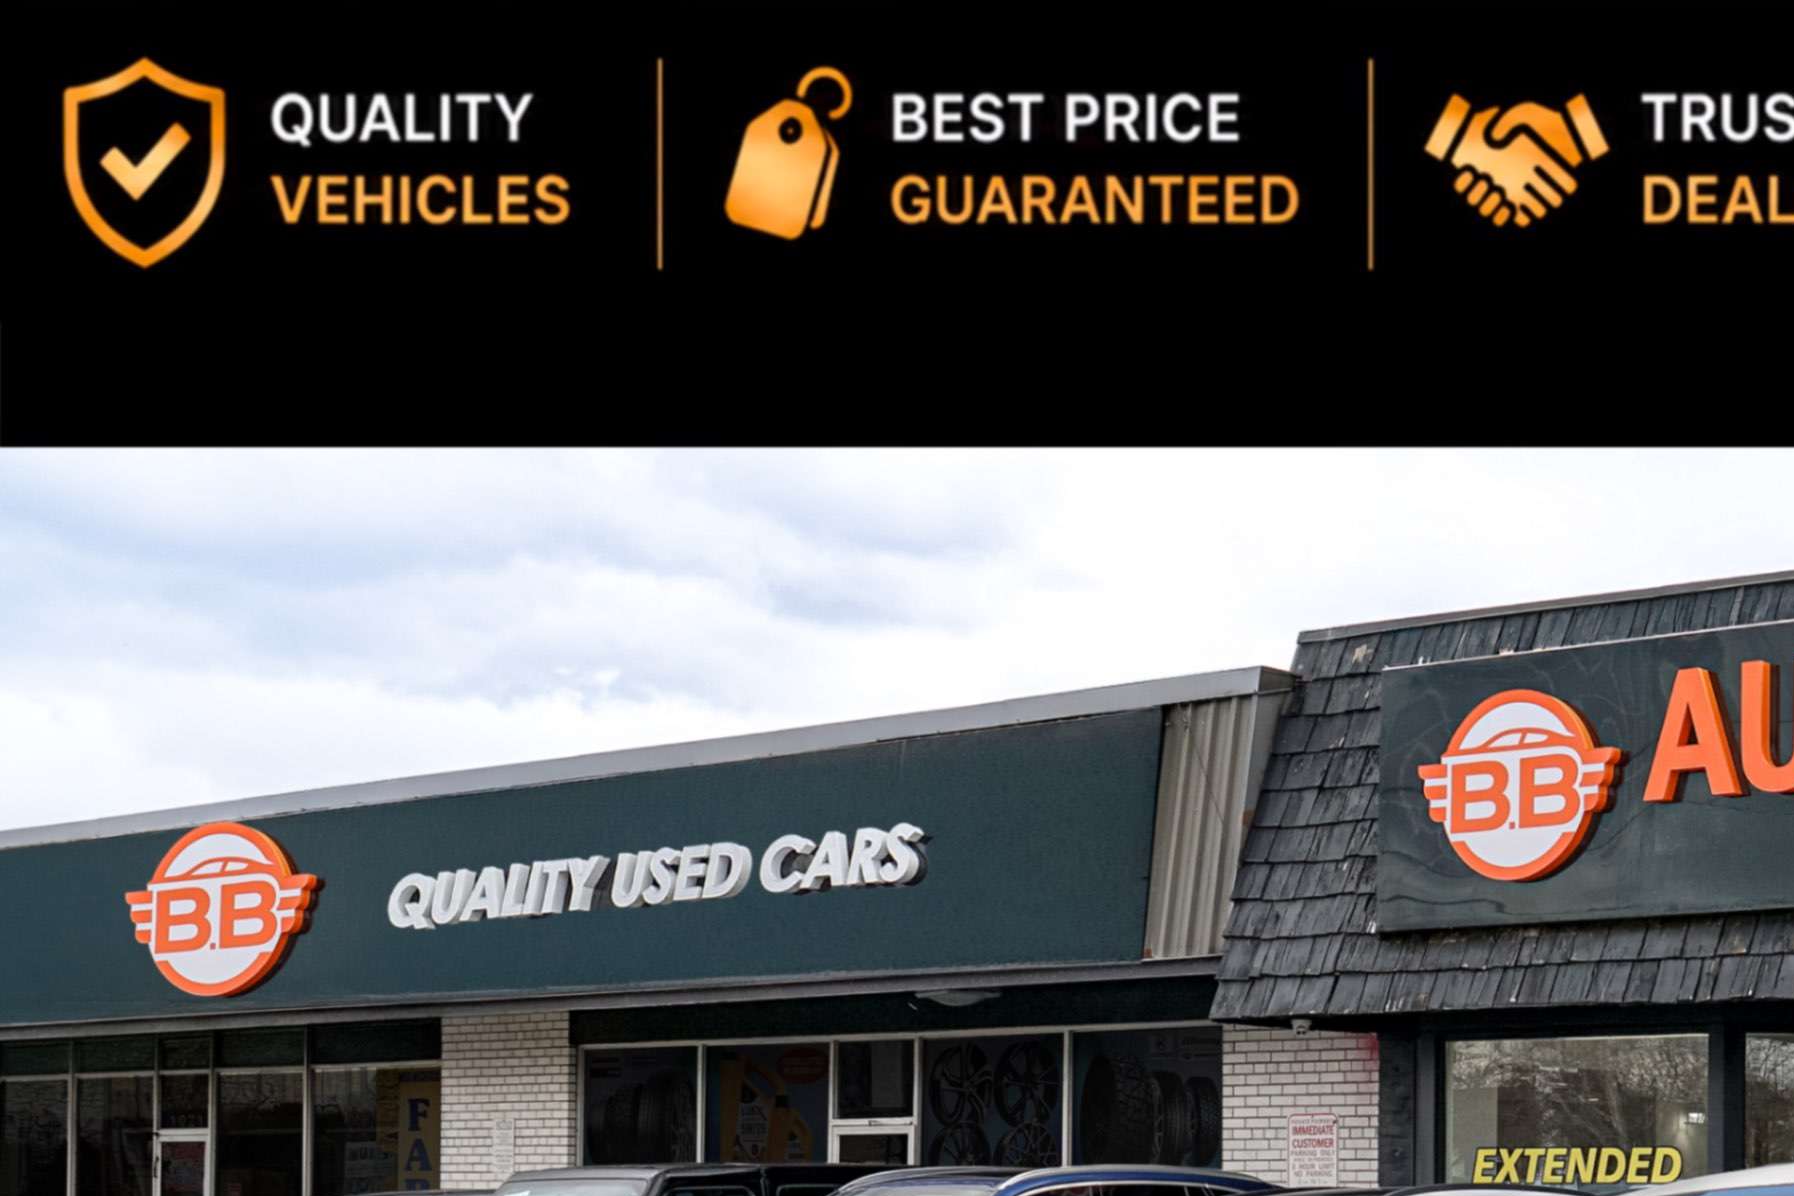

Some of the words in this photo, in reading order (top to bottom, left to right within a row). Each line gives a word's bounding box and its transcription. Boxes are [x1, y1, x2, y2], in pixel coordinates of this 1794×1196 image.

[388, 855, 608, 929] QUALITY
[612, 841, 752, 907] USED
[760, 822, 927, 893] CARS
[1292, 1126, 1335, 1135] IMMEDIATE
[1292, 1138, 1334, 1148] CUSTOMER
[1473, 1146, 1683, 1185] EXTENDED
